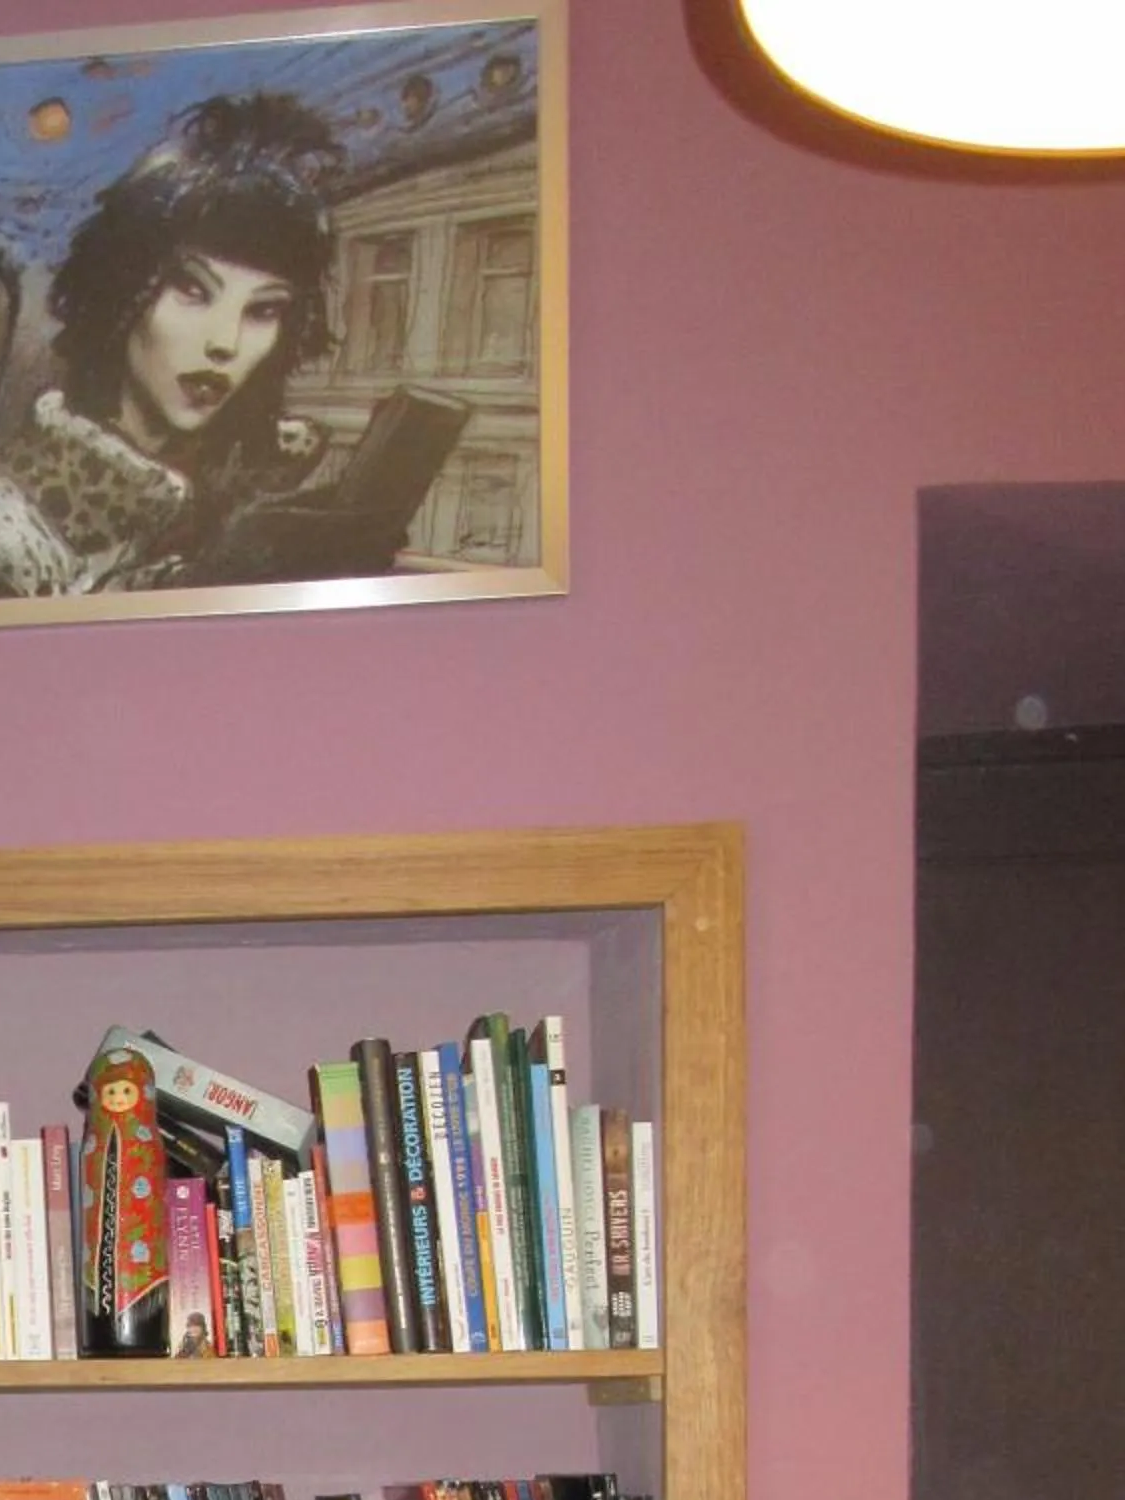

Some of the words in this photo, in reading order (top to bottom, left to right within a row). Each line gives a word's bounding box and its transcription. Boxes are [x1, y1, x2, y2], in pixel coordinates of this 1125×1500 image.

[399, 1067, 423, 1183] DÉCORATION
[412, 1206, 436, 1306] INTÉRIEURS
[584, 1230, 601, 1290] Perfect
